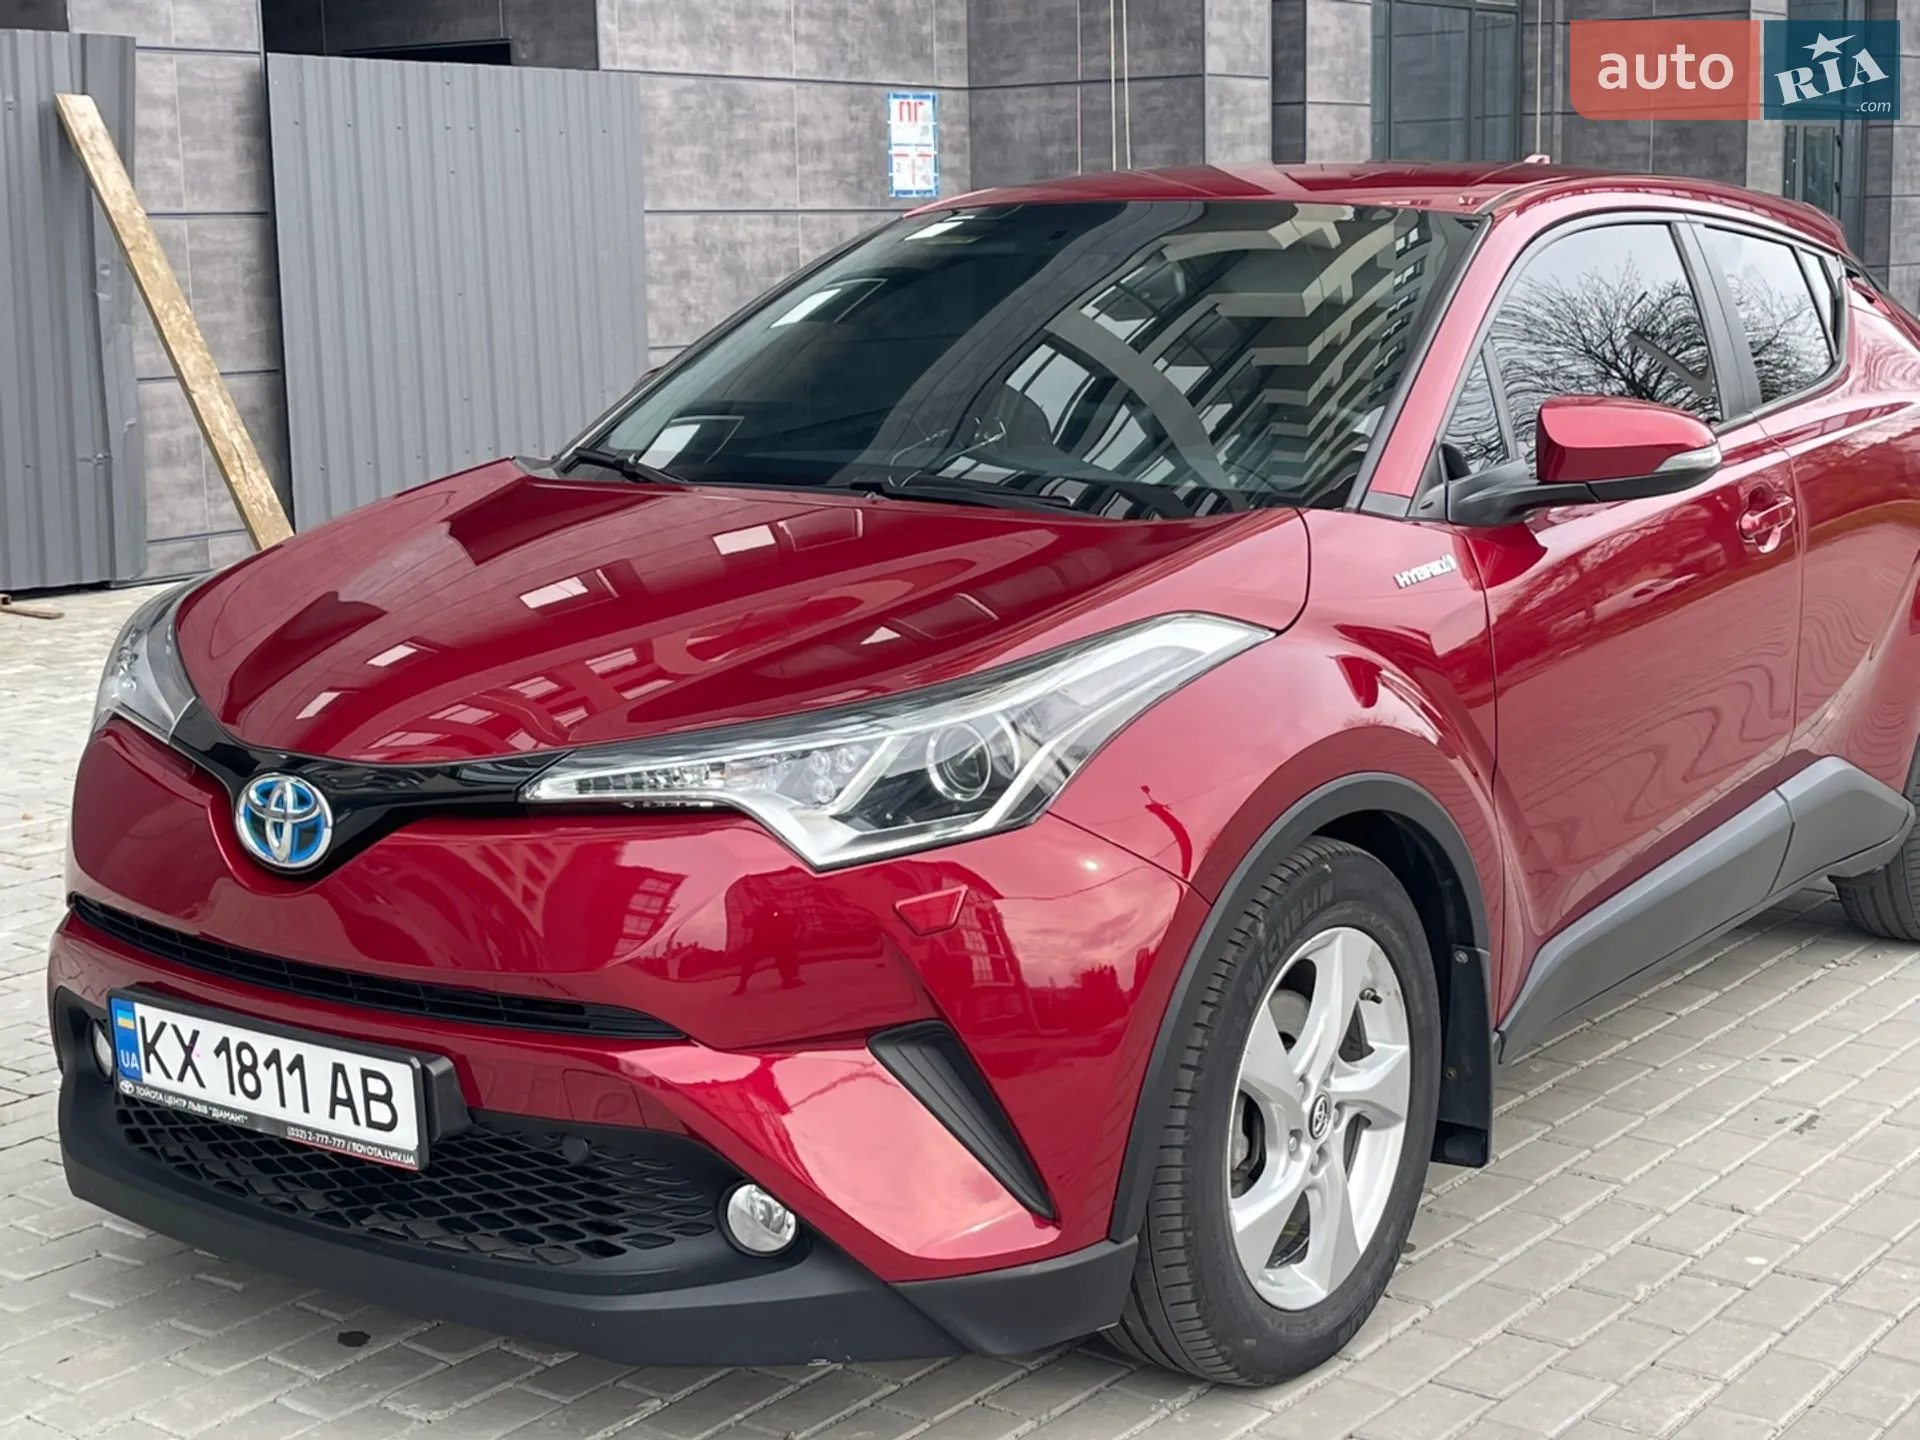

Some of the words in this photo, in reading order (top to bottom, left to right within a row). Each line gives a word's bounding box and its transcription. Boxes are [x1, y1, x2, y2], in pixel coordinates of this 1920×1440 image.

[1393, 554, 1455, 589] HYBRID
[121, 1049, 140, 1072] UA
[140, 1015, 207, 1089] KX
[213, 1036, 311, 1114] 1811
[329, 1061, 399, 1132] AB
[164, 1095, 187, 1109] ЦЕНТР
[307, 1131, 346, 1149] 2-777-777
